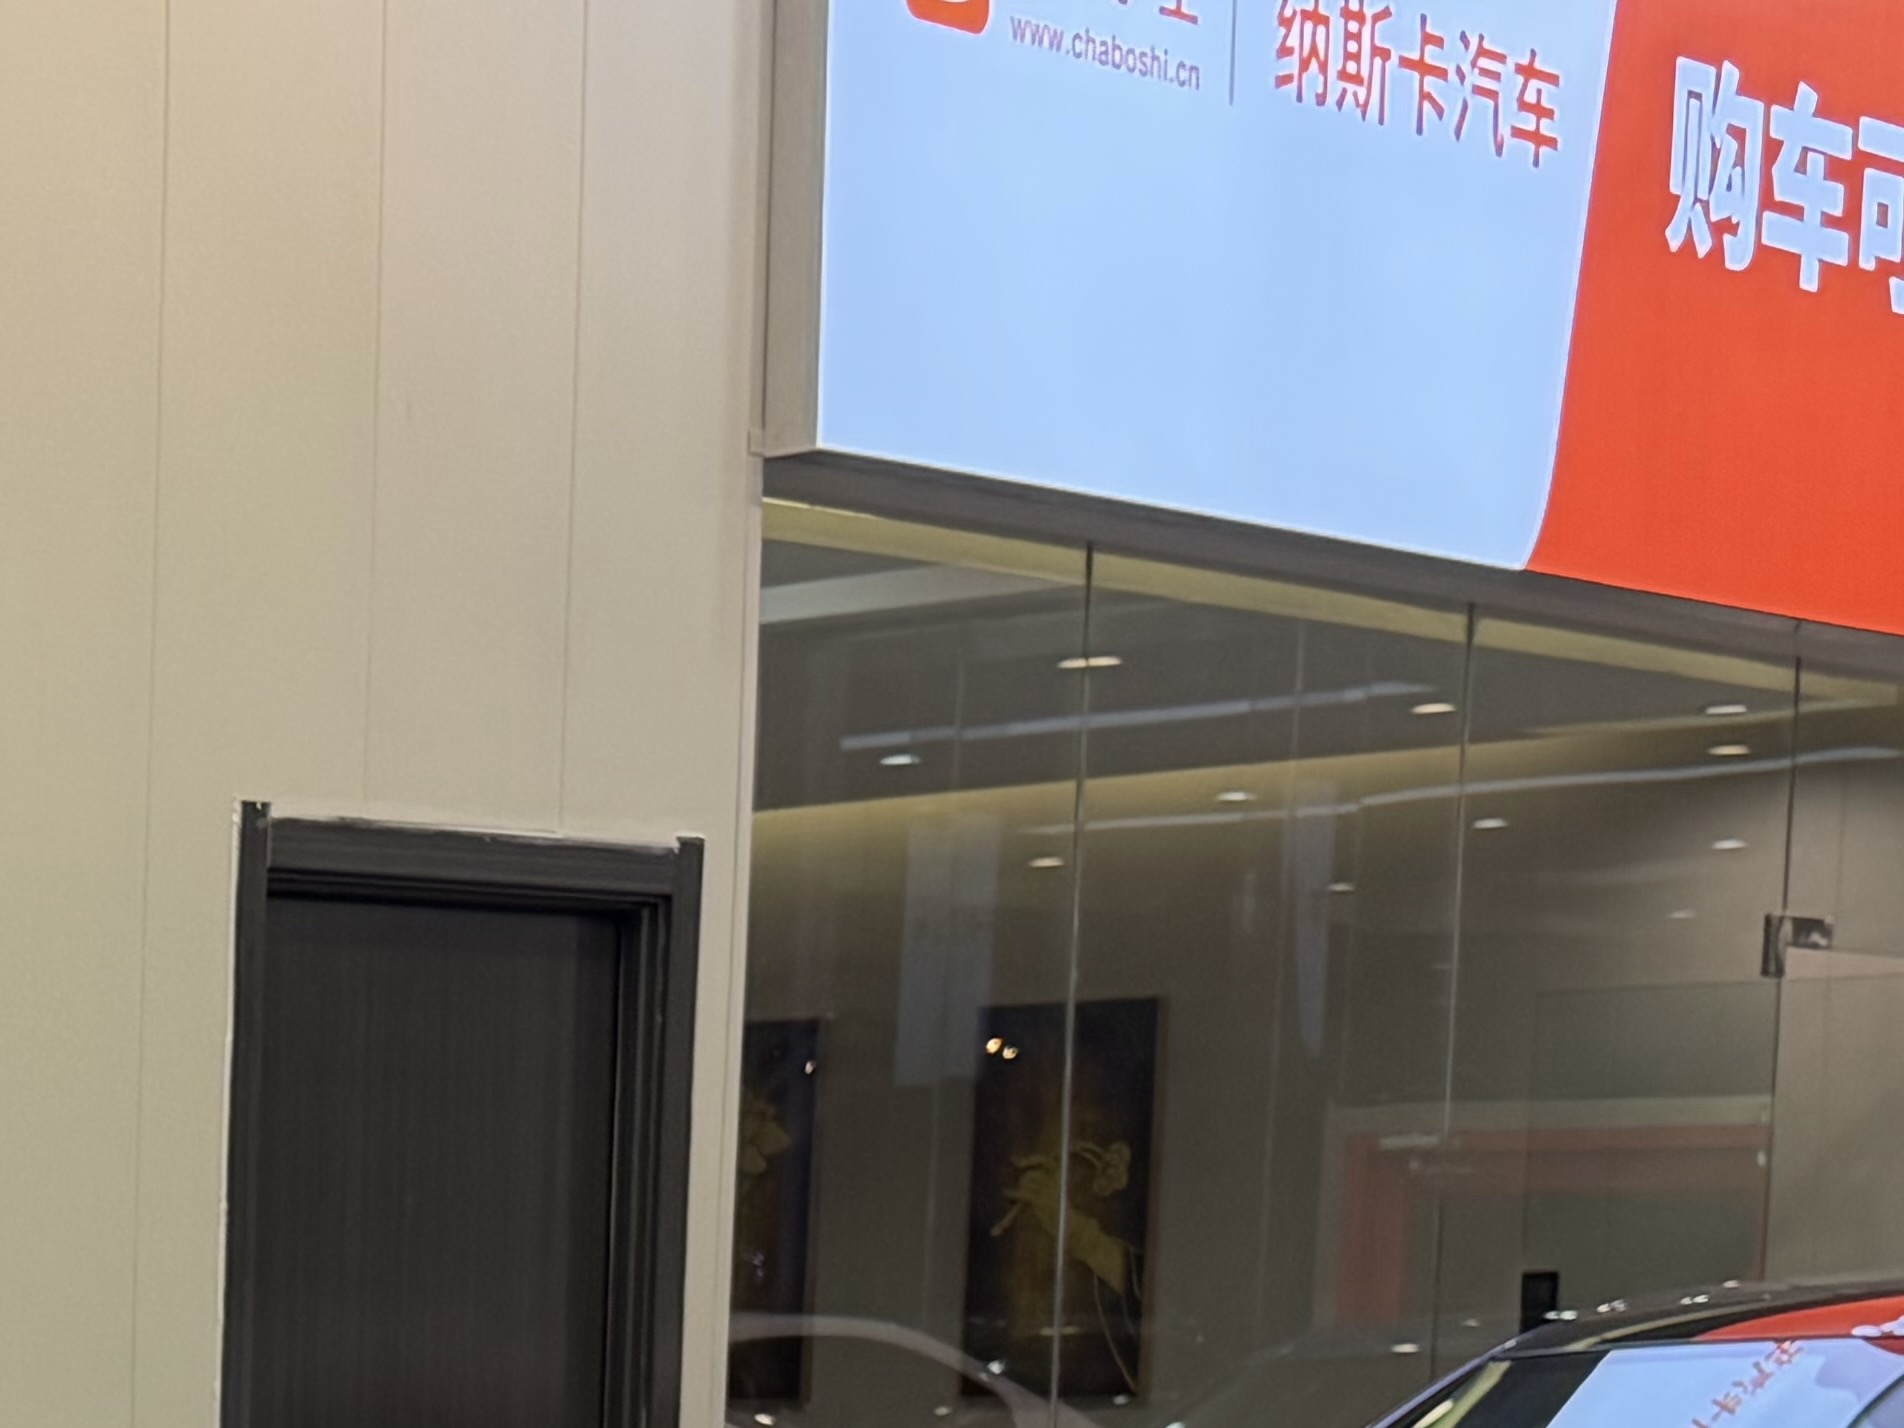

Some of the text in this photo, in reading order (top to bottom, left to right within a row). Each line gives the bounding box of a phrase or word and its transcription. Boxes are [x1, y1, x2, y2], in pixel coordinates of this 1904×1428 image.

[1010, 16, 1200, 90] www.chaboshi.cn
[1275, 0, 1560, 168] 纳斯卡汽车
